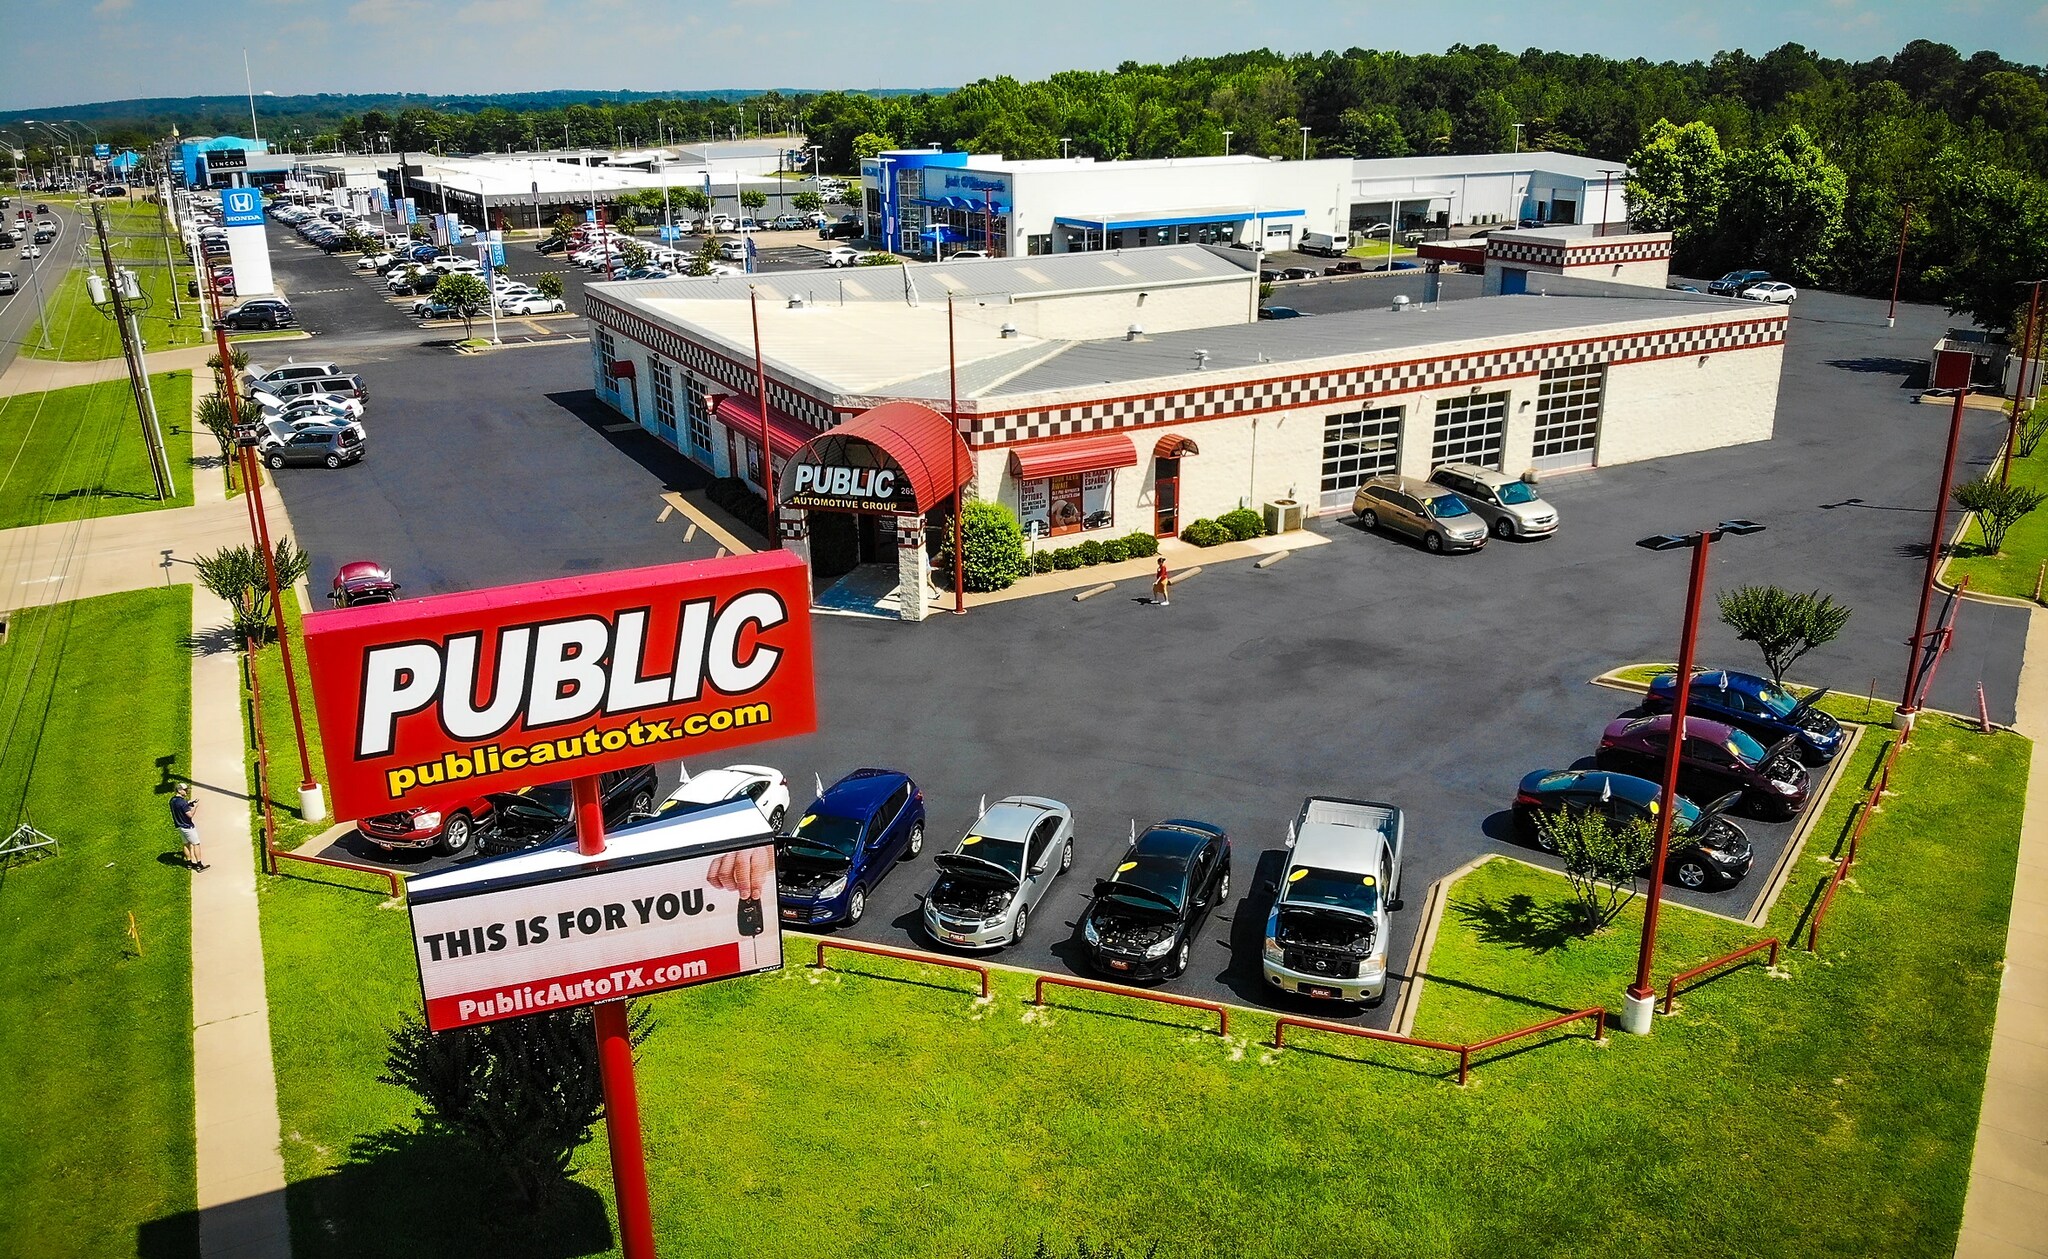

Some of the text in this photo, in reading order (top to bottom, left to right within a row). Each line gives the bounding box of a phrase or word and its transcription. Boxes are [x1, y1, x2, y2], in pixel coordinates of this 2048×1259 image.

[210, 160, 244, 168] LINCOLN
[226, 214, 261, 222] HONDA
[793, 496, 897, 512] AUTOMOTIVE GROUP
[794, 464, 895, 499] PUBLIC
[356, 589, 787, 760] PUBLIC
[390, 703, 769, 796] publicautotx.com
[423, 888, 716, 962] THIS IS FOR YOU.
[458, 958, 708, 1021] PublicAutoTX.com
